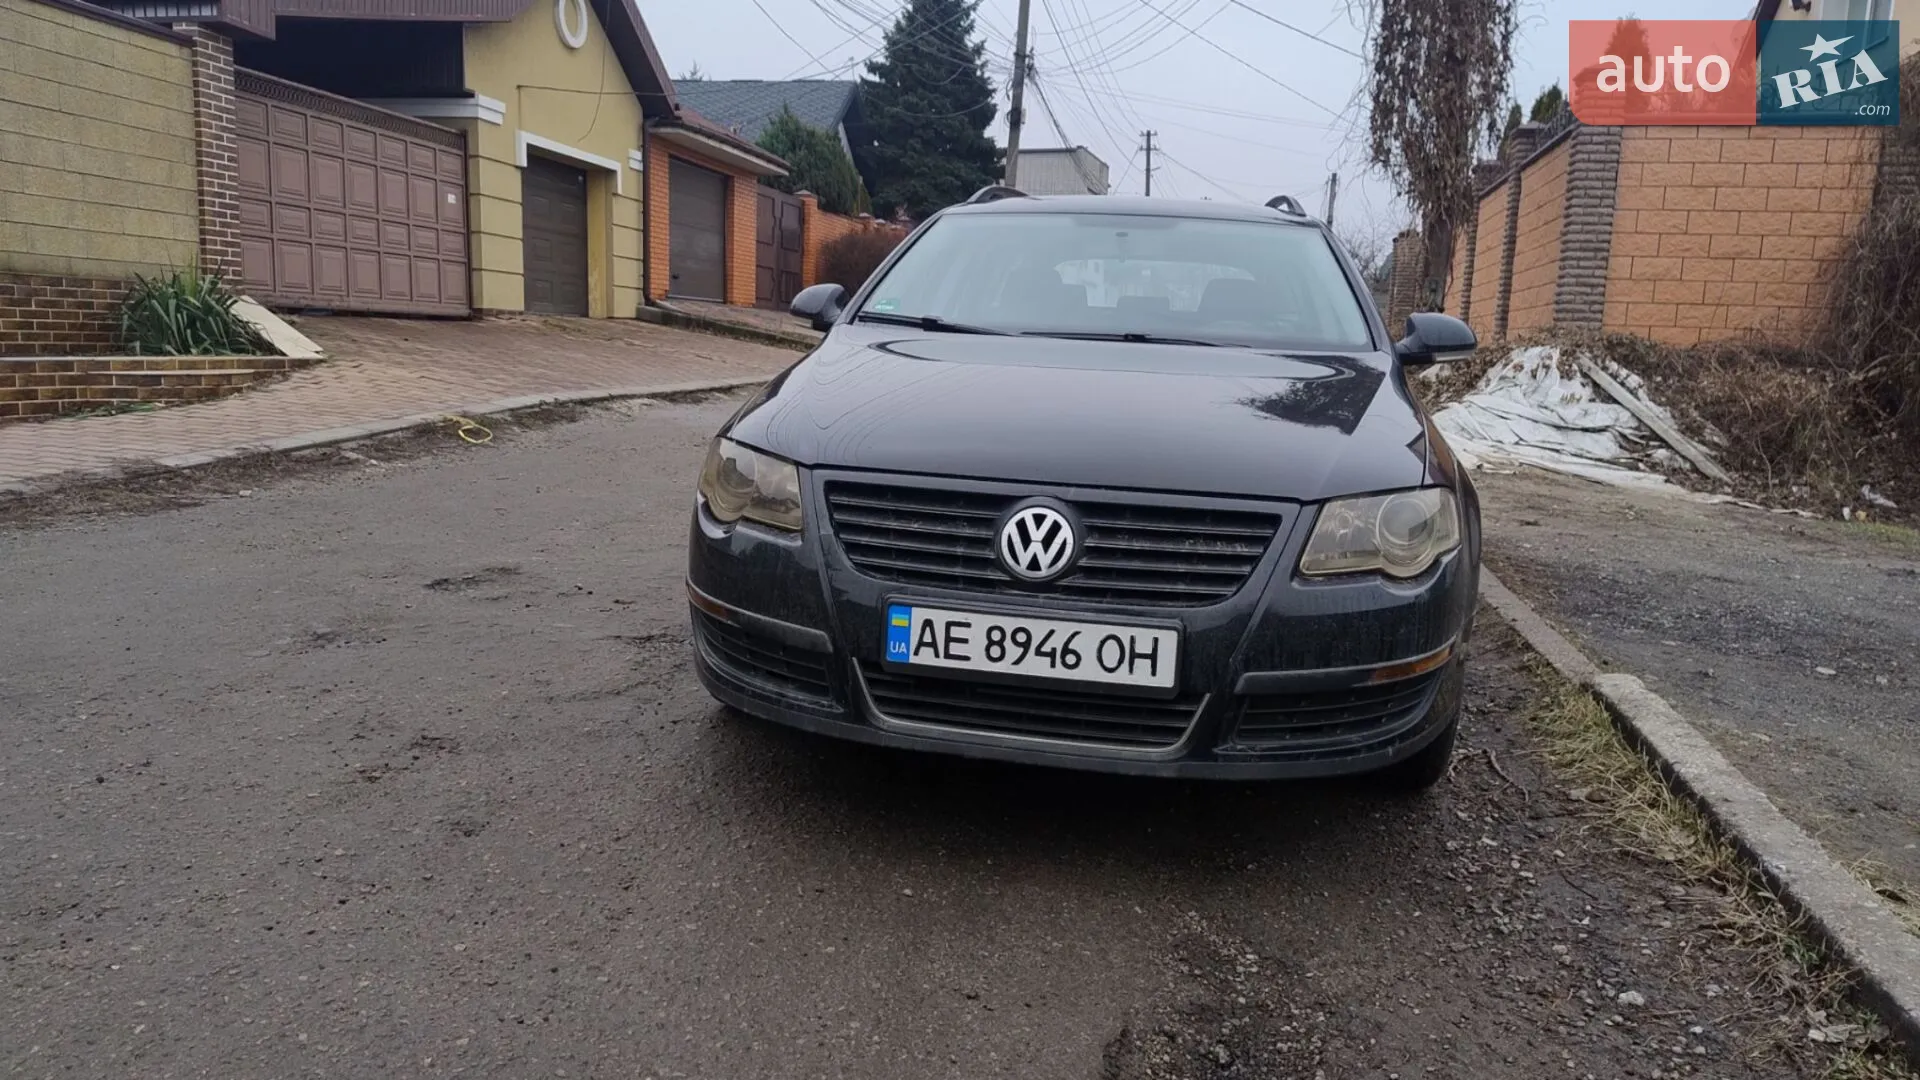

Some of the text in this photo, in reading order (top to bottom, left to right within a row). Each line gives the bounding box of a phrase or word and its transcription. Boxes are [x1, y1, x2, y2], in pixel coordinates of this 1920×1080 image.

[1001, 507, 1074, 578] VW
[890, 641, 908, 654] UA
[913, 618, 1159, 677] AE 8946 OH
